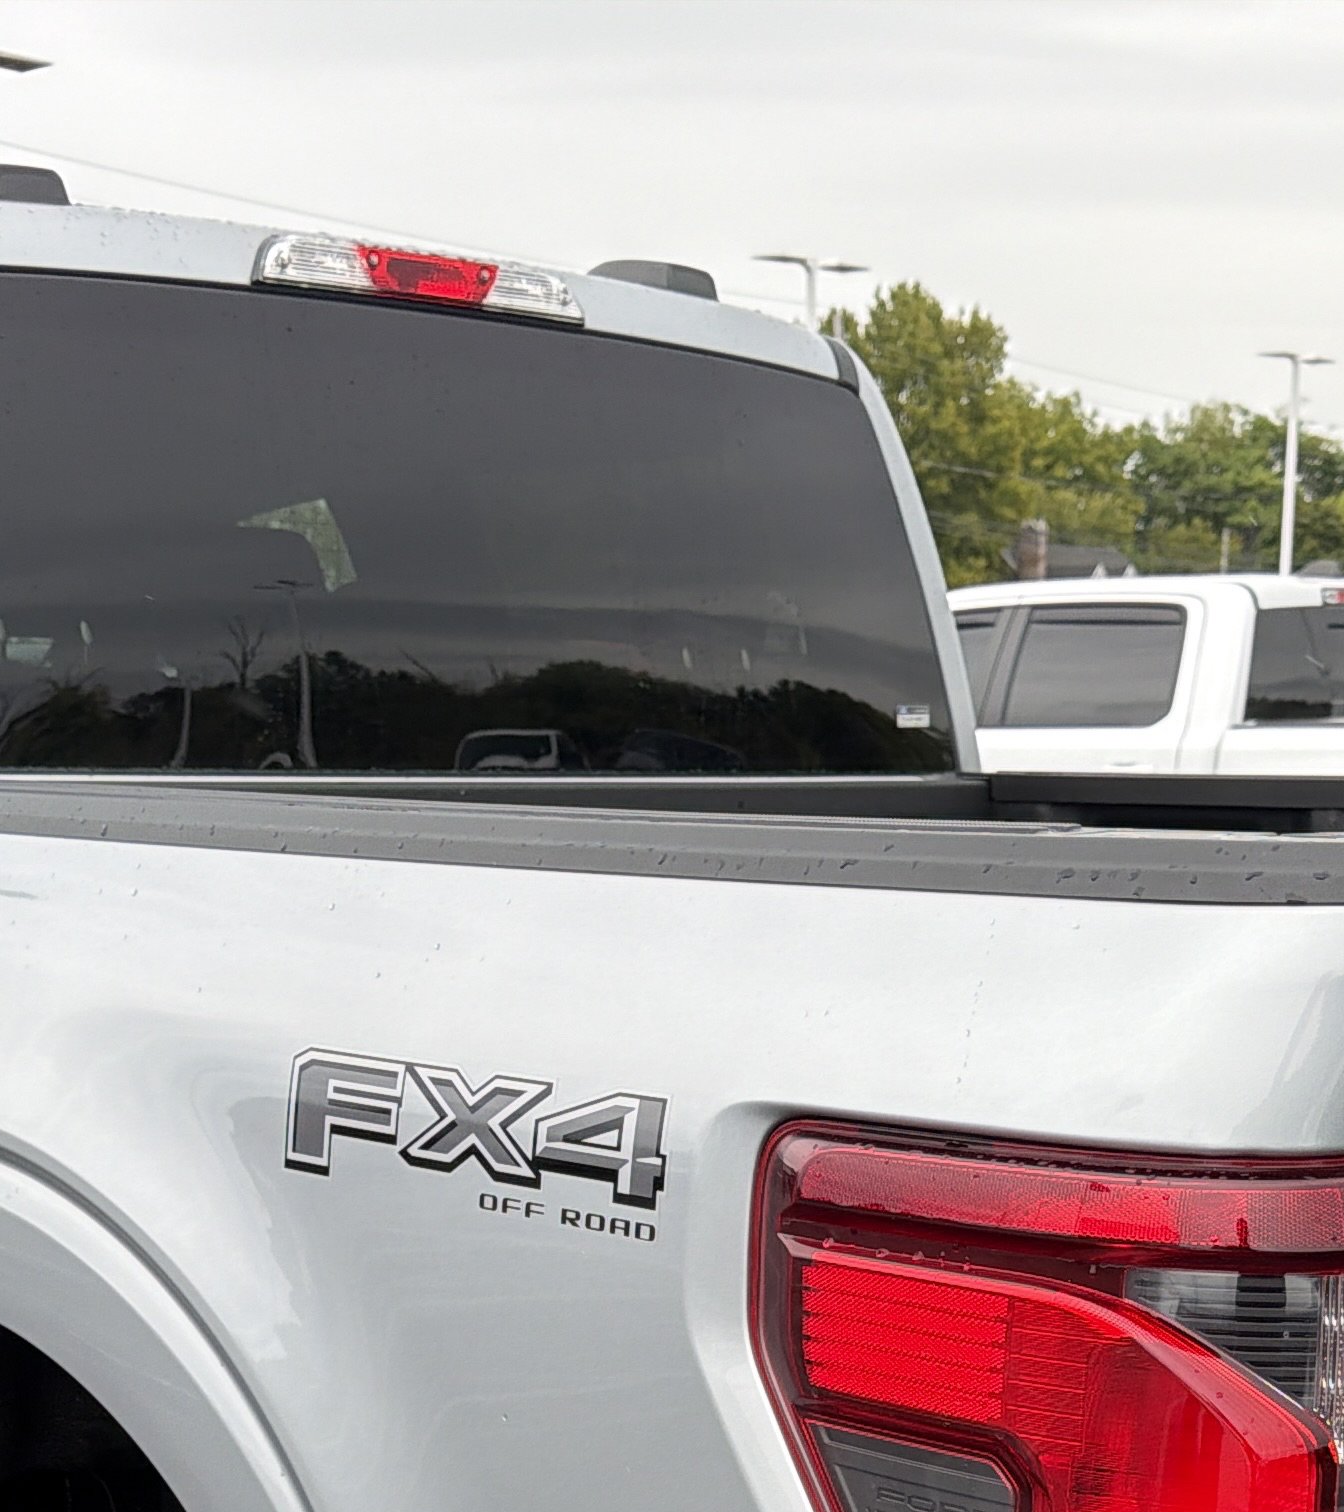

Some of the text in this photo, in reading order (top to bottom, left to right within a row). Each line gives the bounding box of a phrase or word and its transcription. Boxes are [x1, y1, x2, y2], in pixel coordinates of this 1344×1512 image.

[284, 1046, 669, 1211] FX4
[478, 1192, 658, 1243] OFF ROAD
